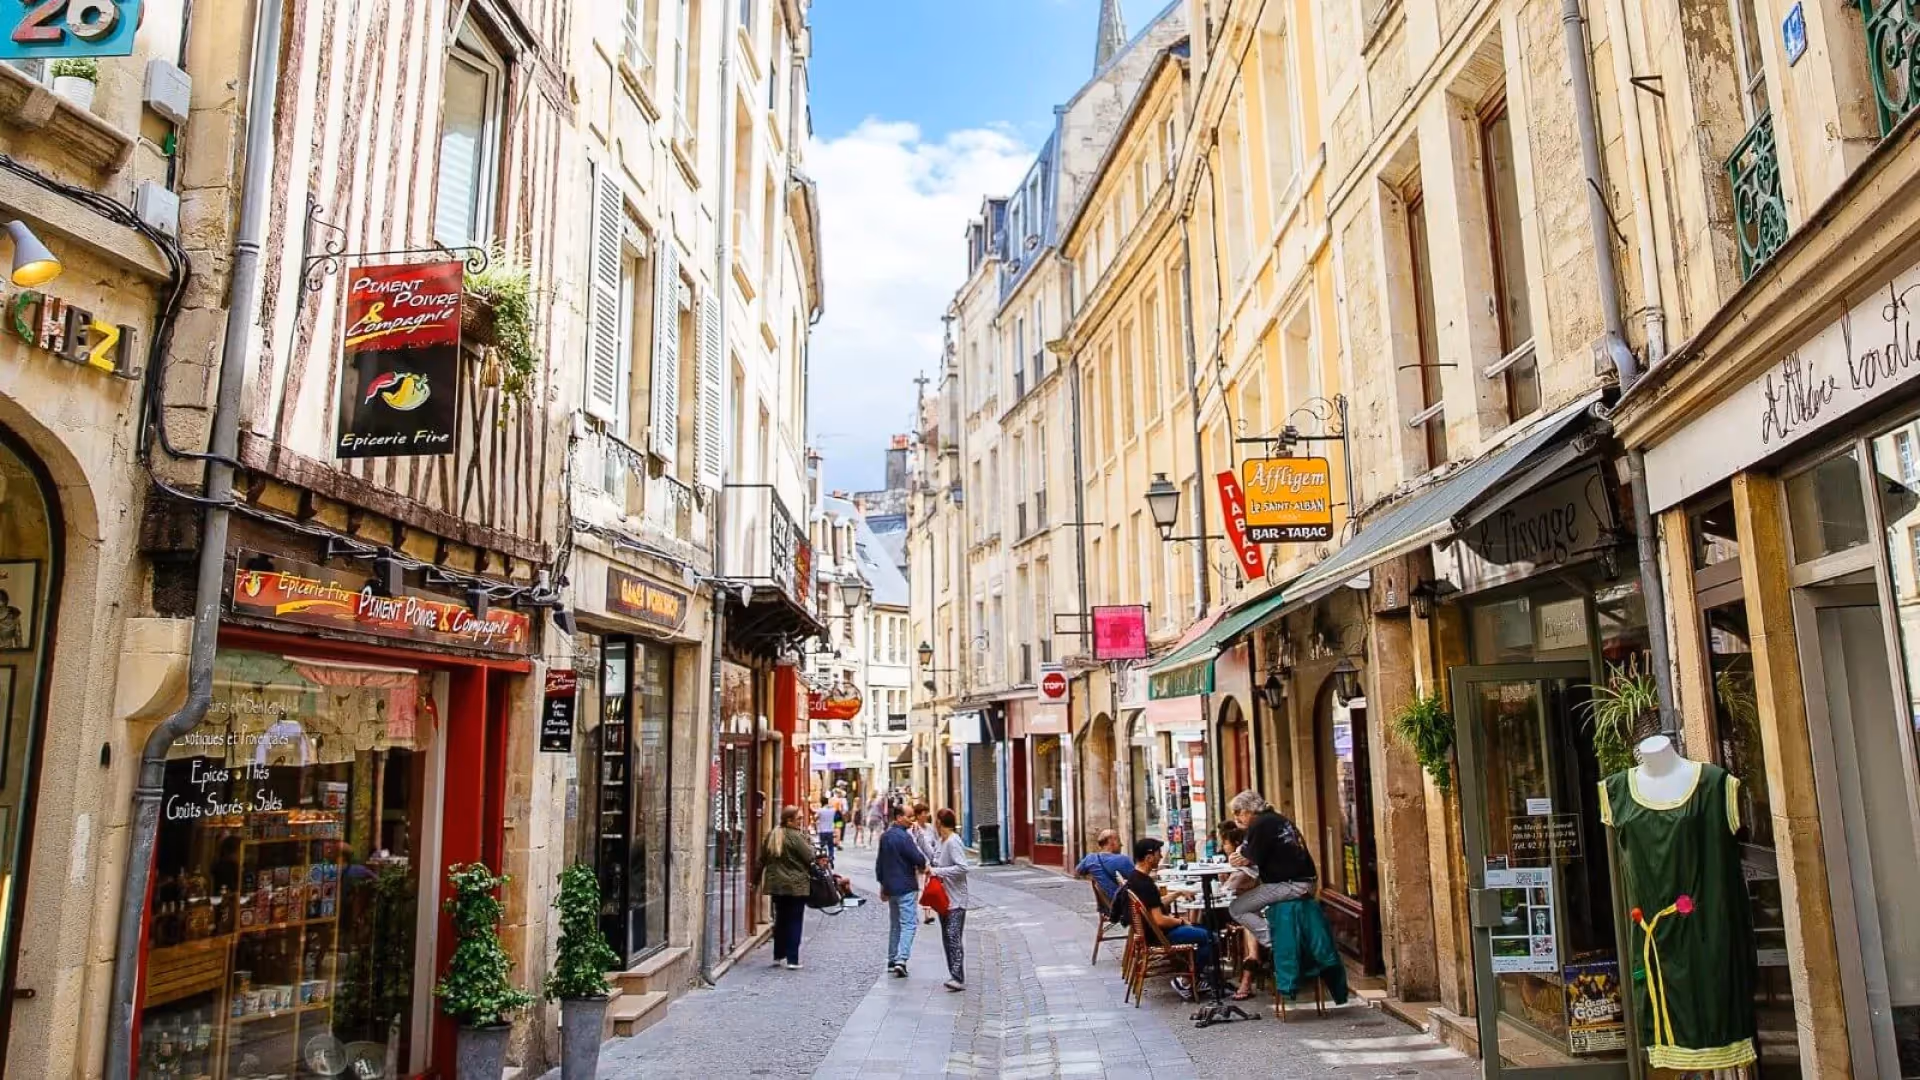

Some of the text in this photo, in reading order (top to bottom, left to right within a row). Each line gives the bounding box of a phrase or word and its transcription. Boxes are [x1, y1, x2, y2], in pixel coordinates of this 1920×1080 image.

[353, 277, 424, 294] PIMENT
[392, 292, 459, 308] POIVRE
[347, 304, 455, 337] Compagnie
[361, 302, 385, 324] &
[341, 430, 449, 451] Epicerie Fine
[1247, 462, 1326, 494] Affligem
[1224, 484, 1259, 565] TABAC
[1501, 502, 1580, 565] Tissage
[278, 570, 351, 602] Epicerie Fine
[358, 585, 508, 646] PIMENT POIVRE & Compagnie
[191, 760, 229, 793] Epices
[166, 789, 283, 820] Goûts Sucrés Salés
[1573, 1003, 1621, 1020] GOSPEL
